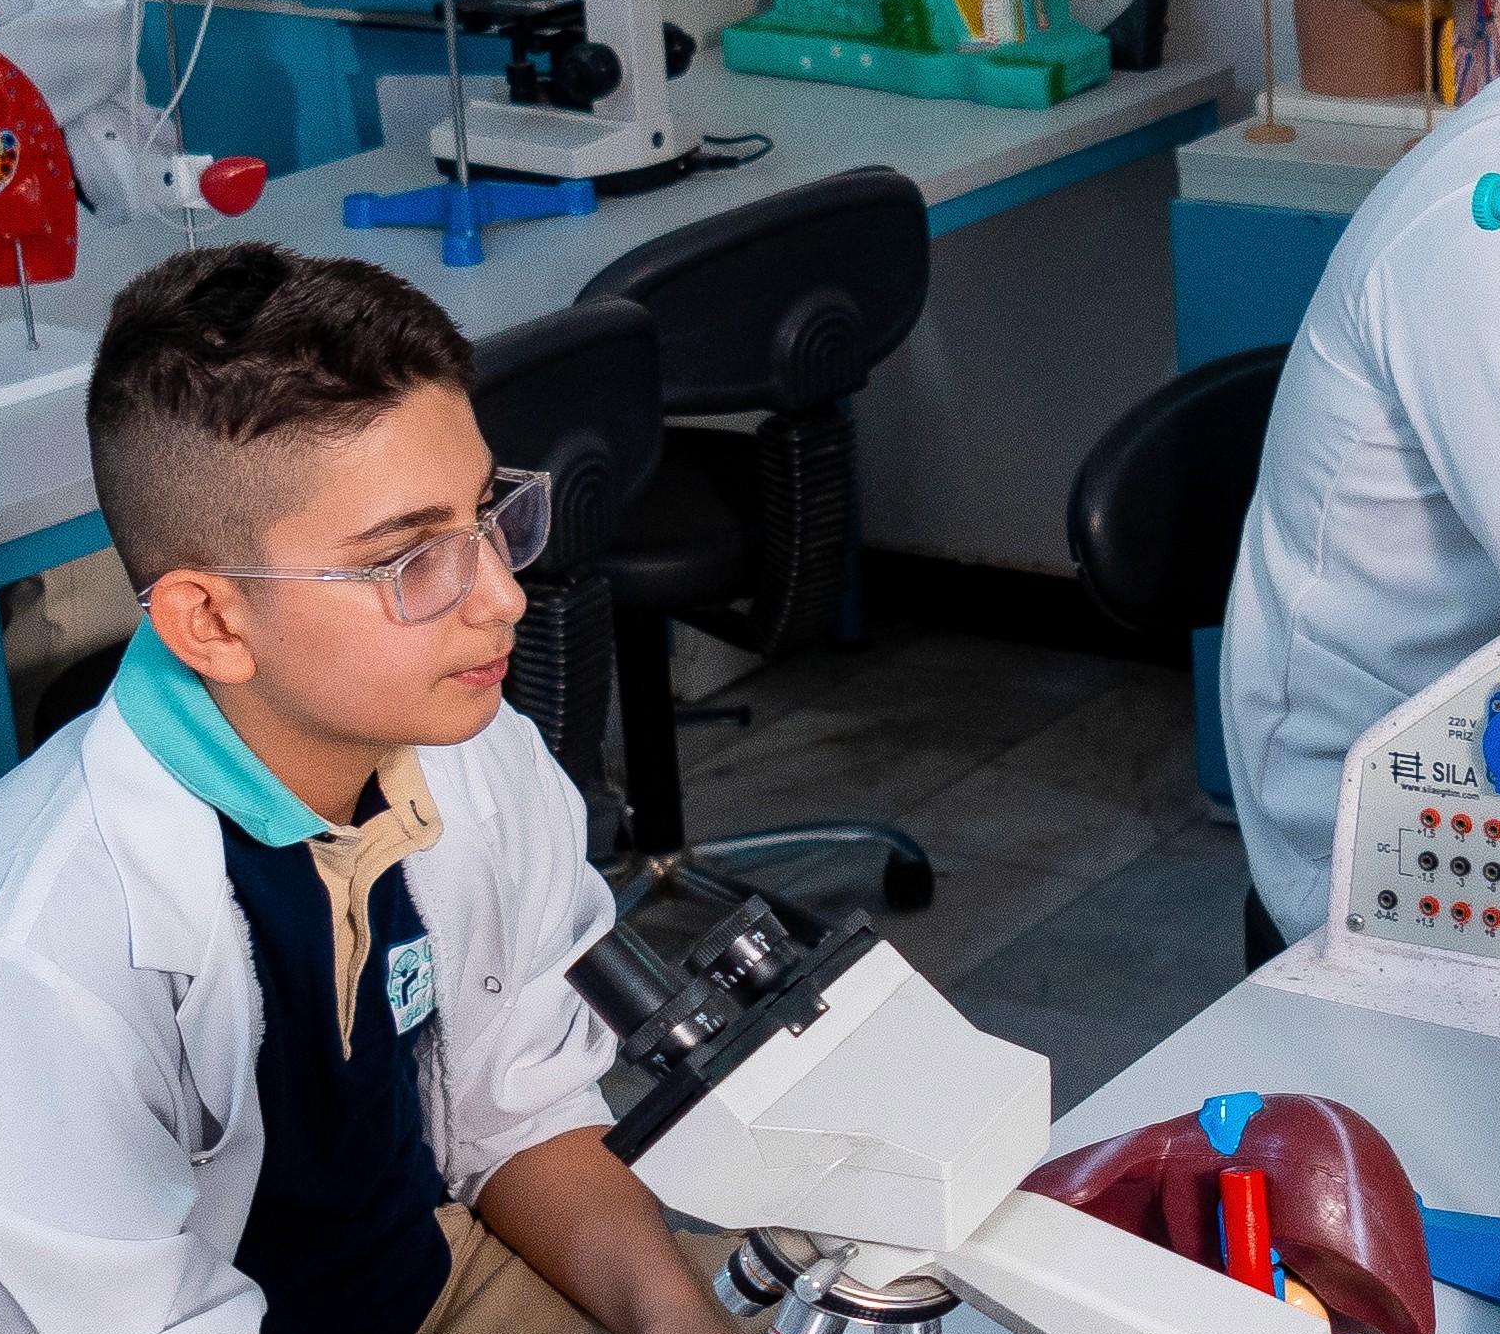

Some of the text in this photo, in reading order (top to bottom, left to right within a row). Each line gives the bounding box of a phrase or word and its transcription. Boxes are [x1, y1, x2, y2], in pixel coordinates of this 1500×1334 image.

[1448, 717, 1477, 728] 220 V
[1432, 760, 1479, 788] SILA
[1377, 842, 1391, 854] DC
